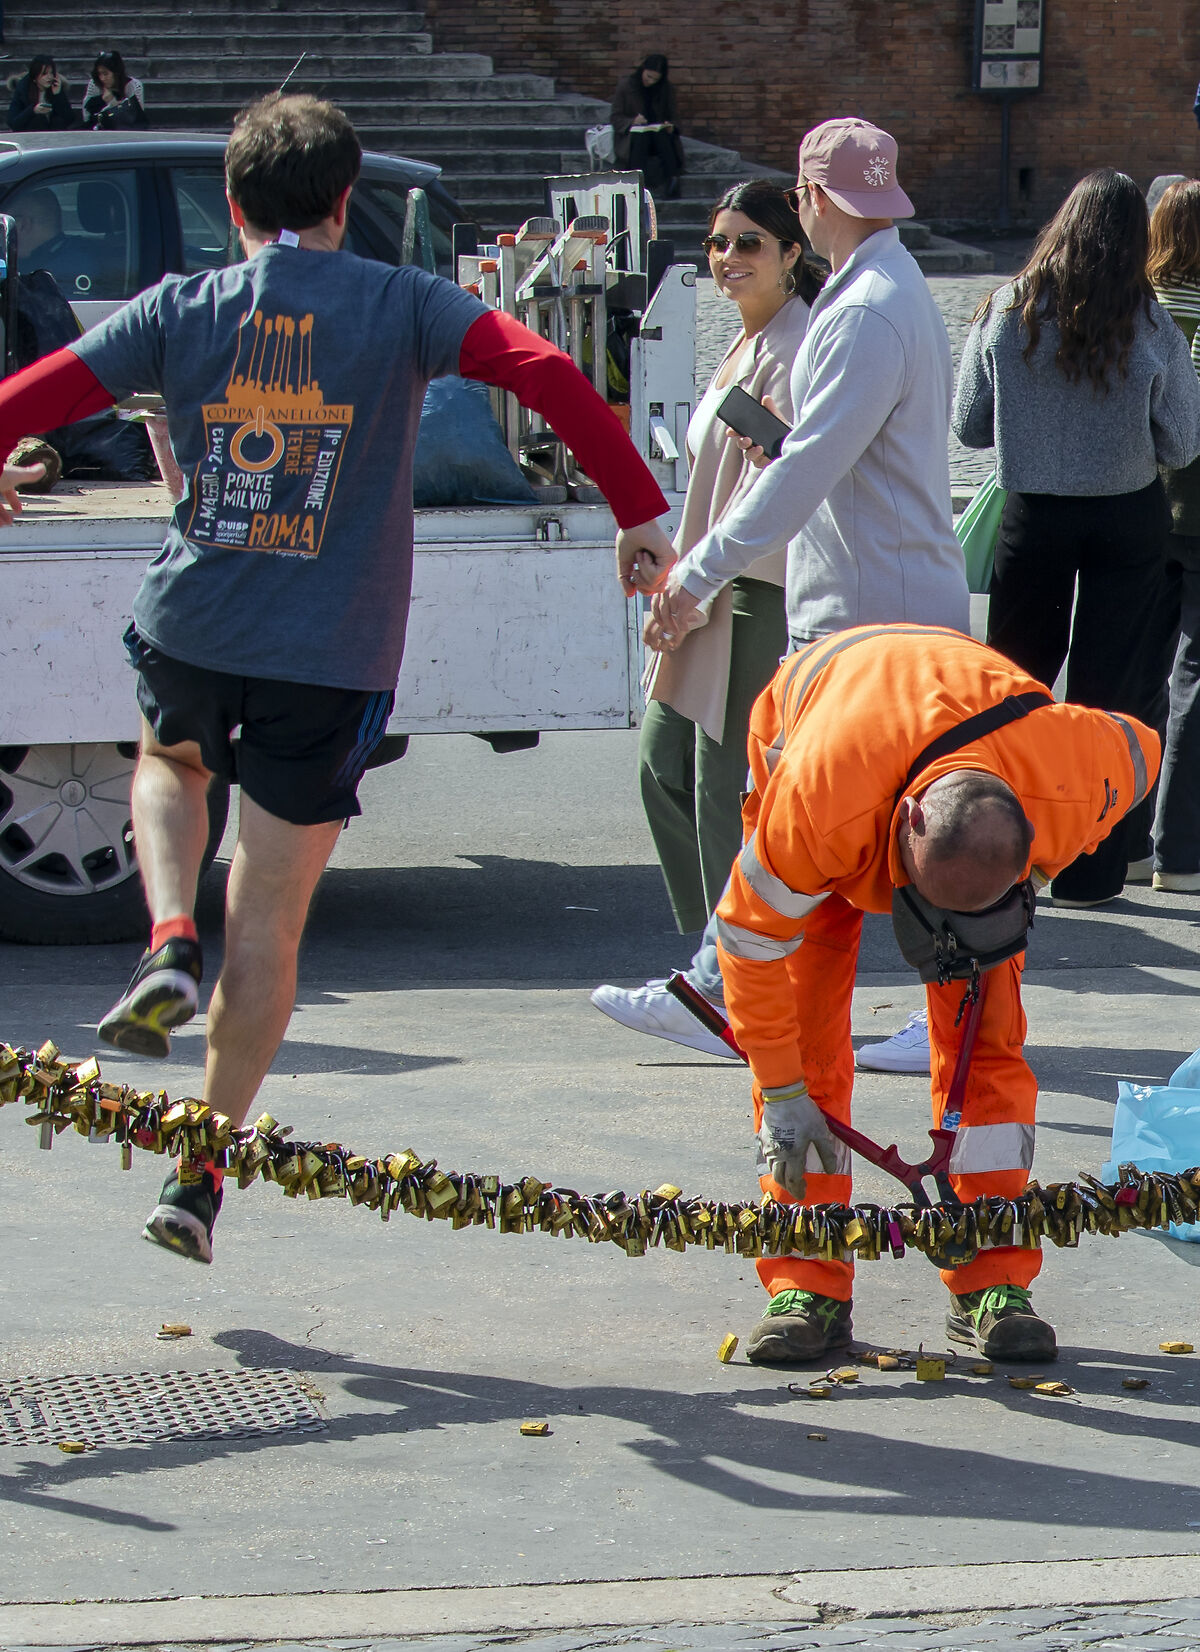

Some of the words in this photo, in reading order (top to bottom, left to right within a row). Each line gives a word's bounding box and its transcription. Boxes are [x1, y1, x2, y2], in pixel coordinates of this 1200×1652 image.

[868, 156, 889, 166] EASY
[863, 170, 878, 187] DOES
[207, 407, 254, 421] COPPA
[284, 429, 304, 476] TEVERE
[300, 429, 320, 475] FIUME
[225, 473, 274, 492] PONTE
[304, 450, 335, 511] EDIZIONE
[222, 490, 272, 511] MILVIO
[249, 513, 314, 550] ROMA
